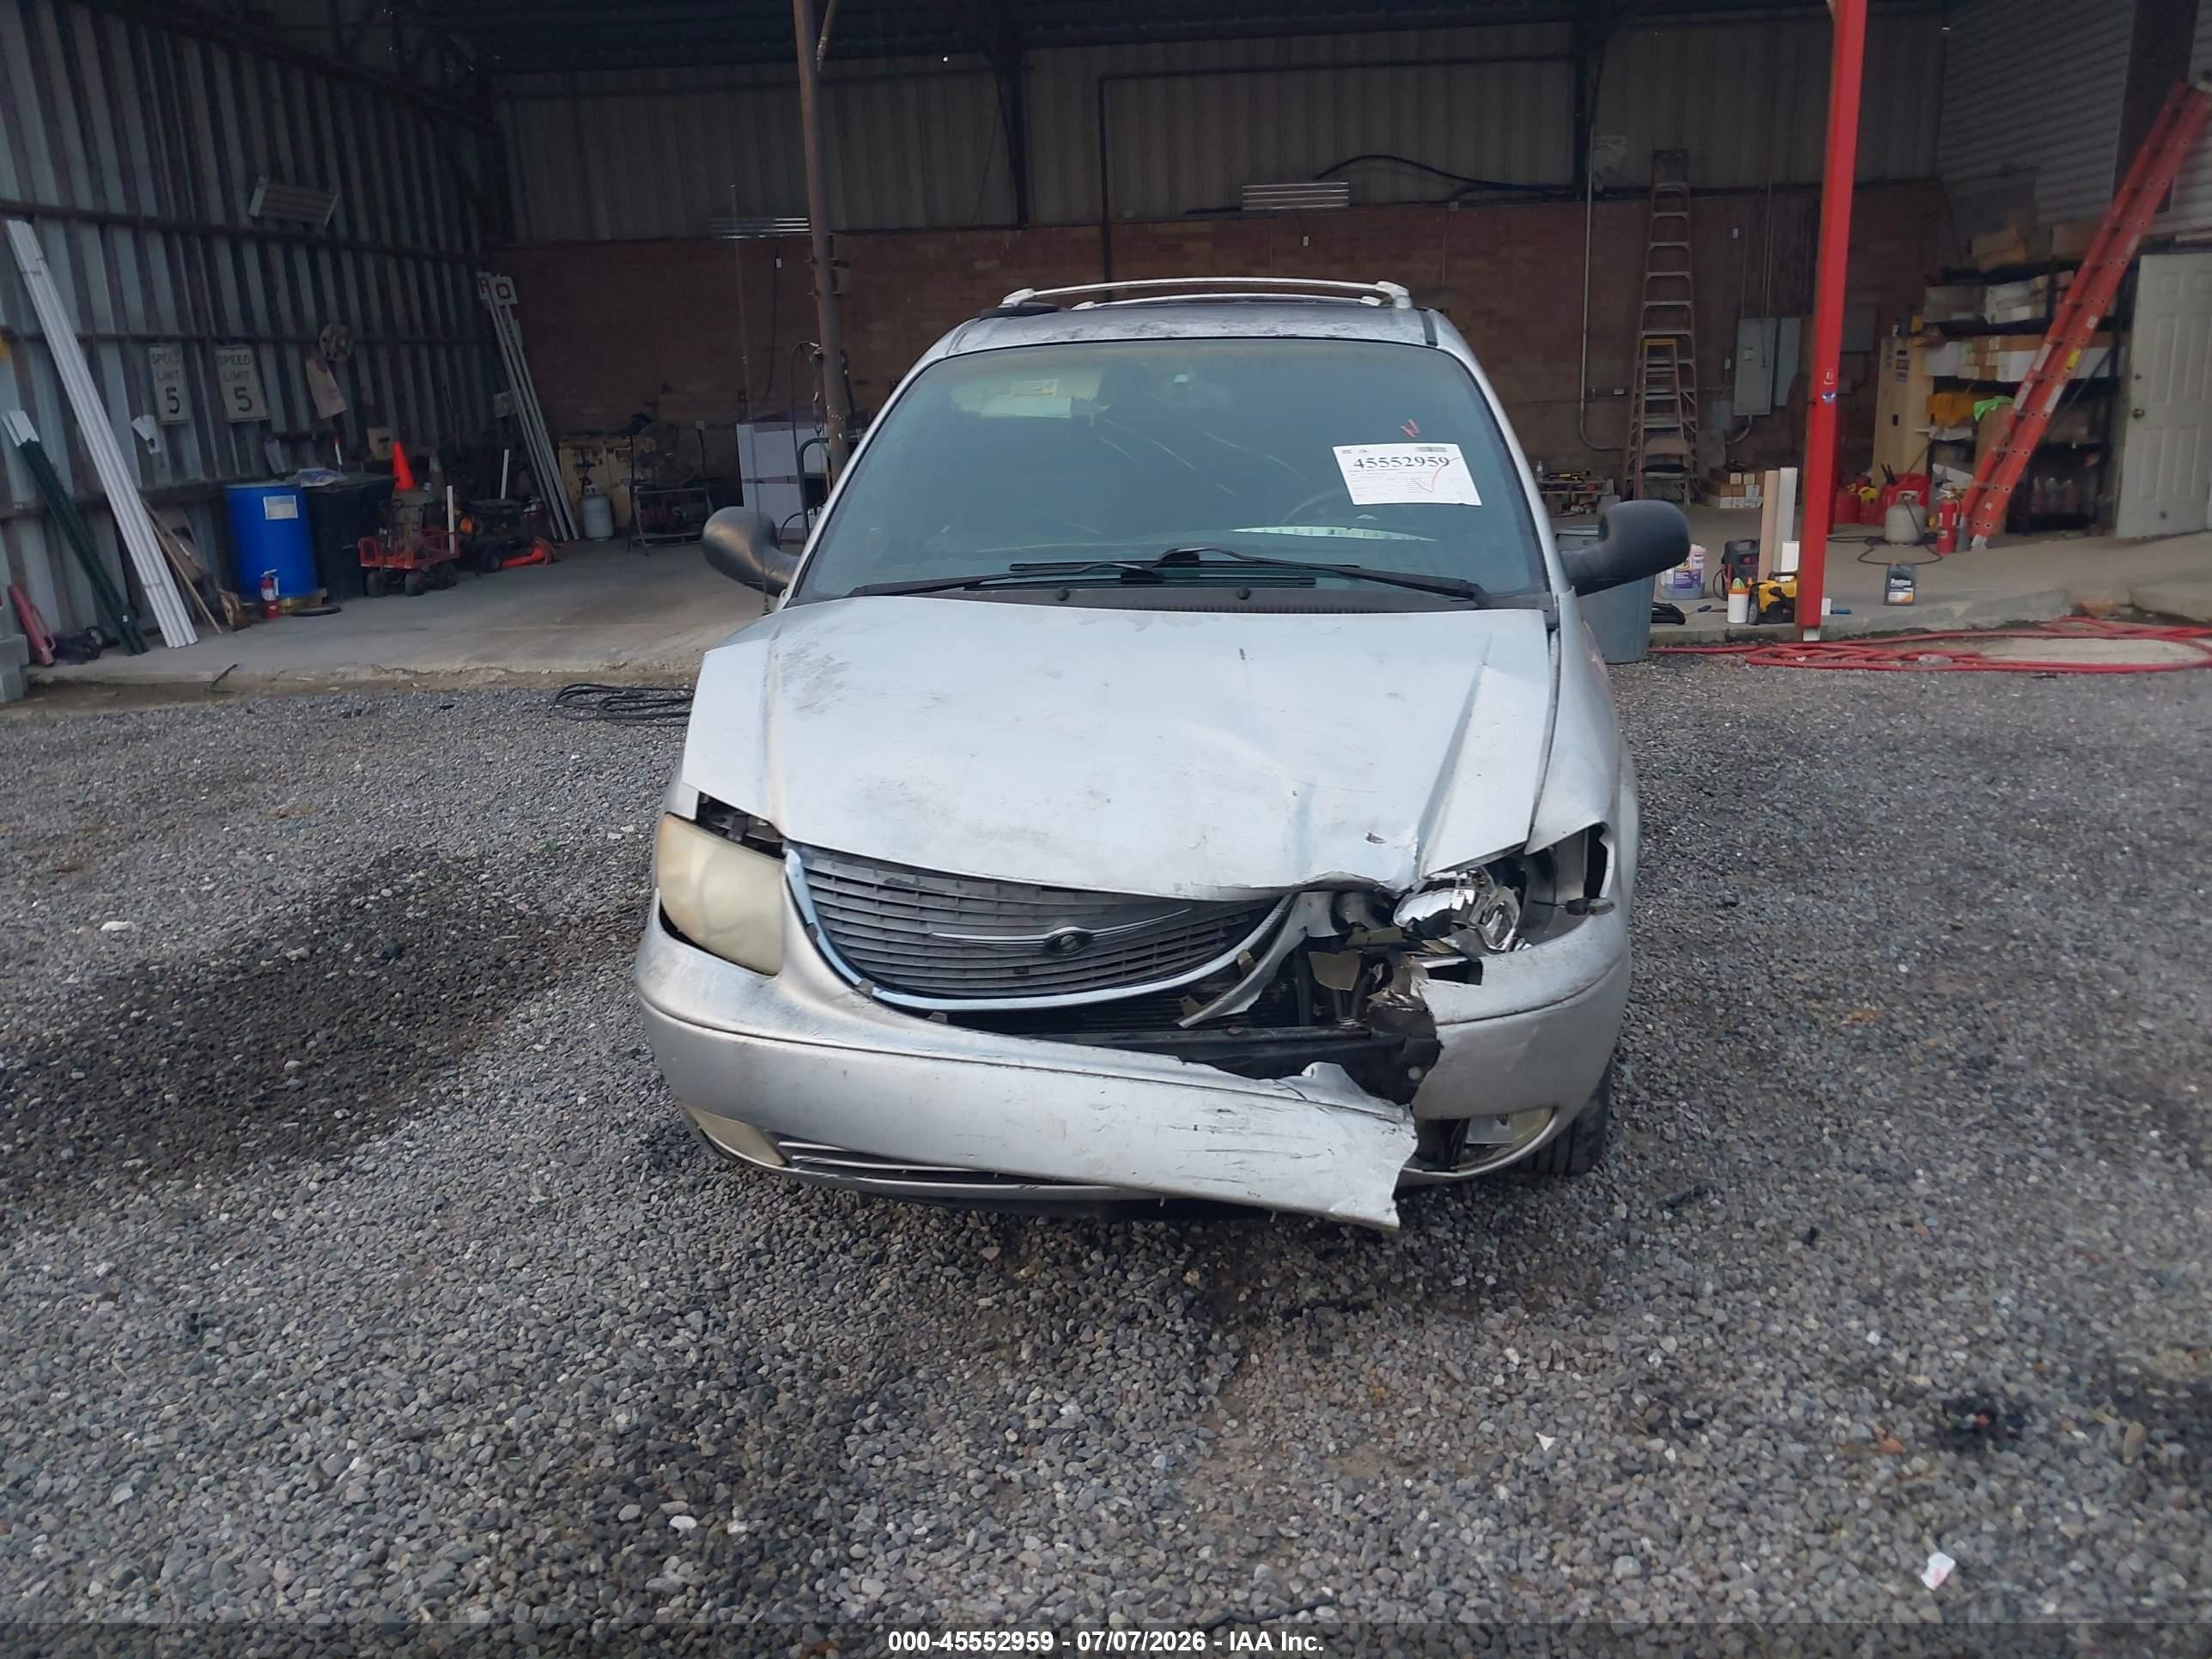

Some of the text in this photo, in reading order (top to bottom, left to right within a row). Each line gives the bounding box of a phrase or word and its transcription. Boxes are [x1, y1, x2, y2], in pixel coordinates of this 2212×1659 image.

[219, 354, 251, 366] SPEED
[223, 370, 250, 382] LIMIT
[165, 386, 180, 414] 5
[234, 386, 252, 412] 5
[1353, 455, 1450, 469] 45552959
